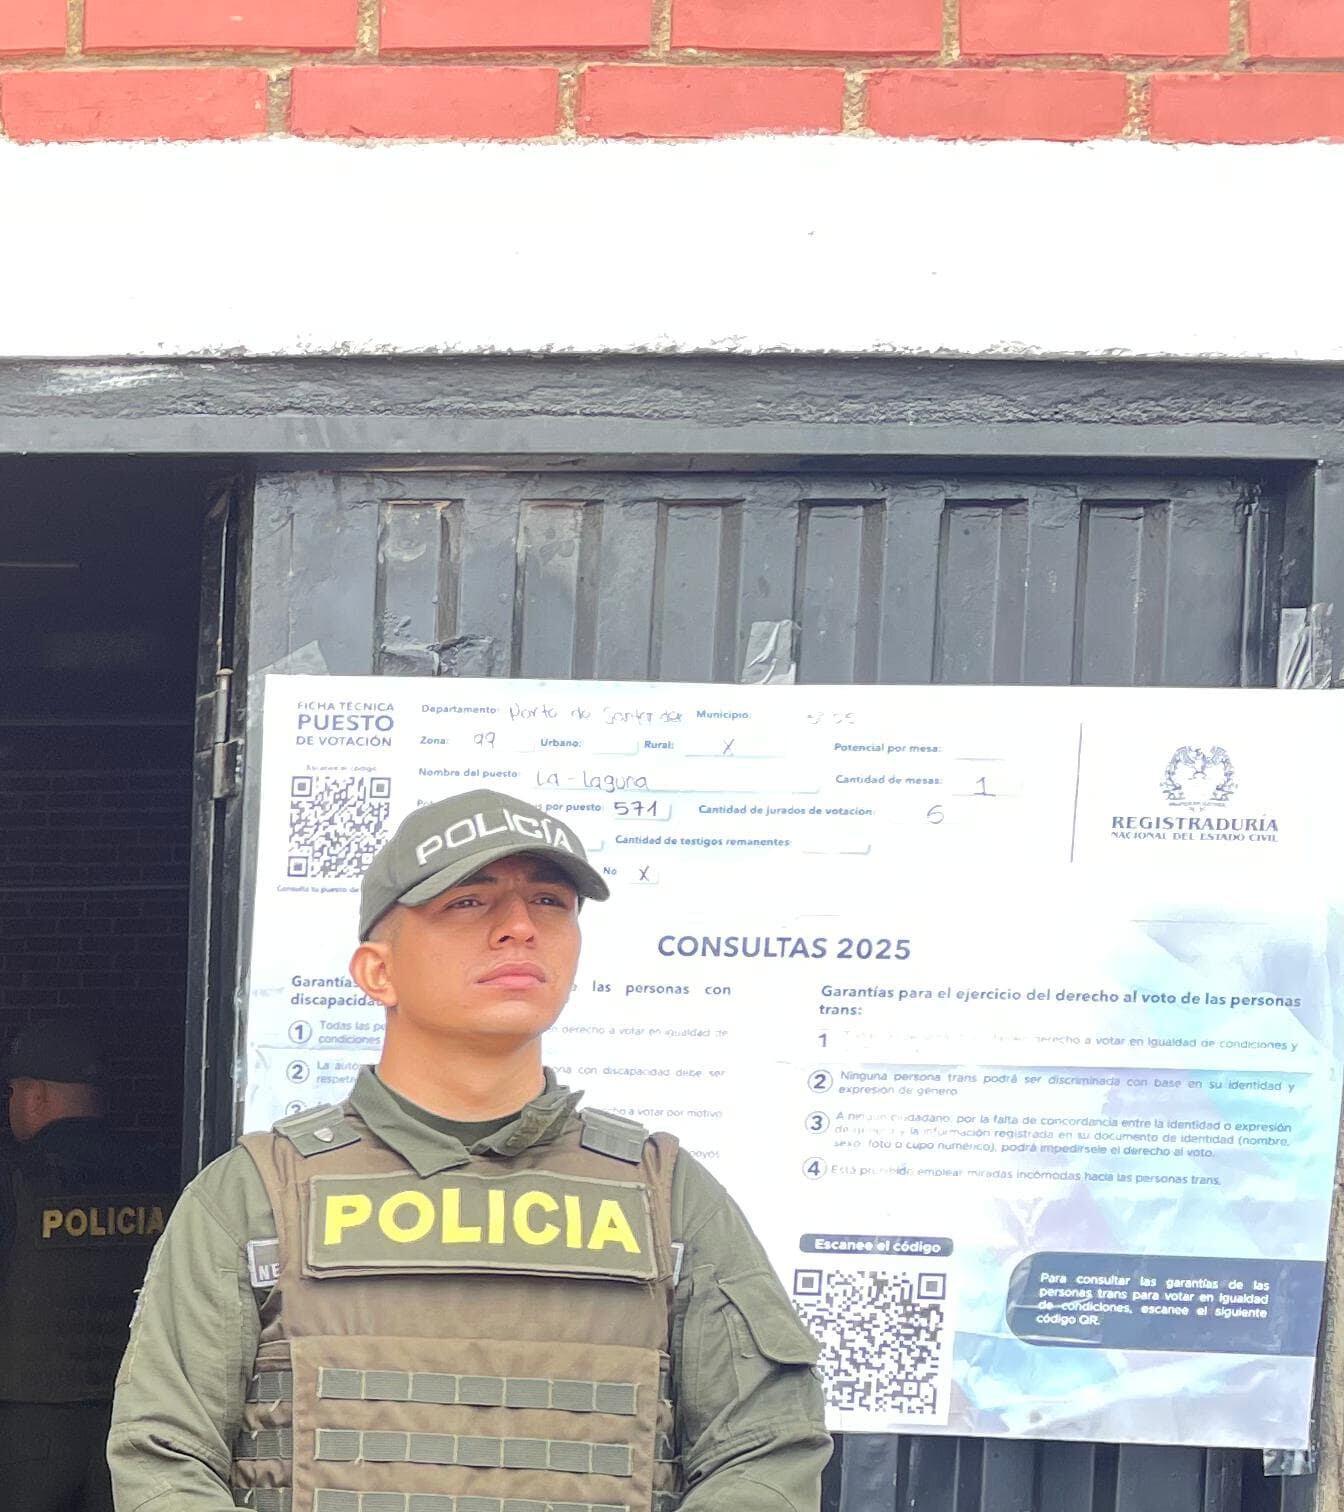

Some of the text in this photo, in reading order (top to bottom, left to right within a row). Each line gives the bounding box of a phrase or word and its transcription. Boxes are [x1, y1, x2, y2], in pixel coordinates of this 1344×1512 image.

[297, 701, 335, 711] FICHA
[297, 714, 394, 732] PUESTO
[696, 710, 751, 720] Municipio:
[296, 735, 392, 747] DE VOTACIÓN
[540, 738, 582, 748] Urbano:
[644, 740, 674, 749] Rural:
[833, 742, 944, 755] Potencial por mesa:
[418, 767, 461, 777] Nombre
[463, 768, 481, 777] del
[835, 775, 886, 784] Cantidad
[545, 803, 564, 813] por
[613, 799, 658, 817] 571
[698, 804, 806, 816] Cantidad de jurados
[1111, 813, 1279, 832] REGISTRADURÍA
[415, 808, 574, 866] POLICÍA
[615, 834, 662, 845] Cantidad
[664, 835, 679, 845] de
[680, 836, 723, 848] testigos
[1111, 831, 1167, 840] NACIONAL
[1172, 832, 1195, 841] DEL
[658, 934, 912, 961] CONSULTAS 2025
[592, 980, 612, 993] las
[625, 983, 690, 997] personas
[704, 985, 731, 996] con
[820, 985, 1302, 1009] Garantías para el ejercicio del derecho al voto de las personas
[819, 1003, 864, 1016] trans:
[817, 1032, 827, 1048] 1
[1096, 1036, 1289, 1050] votar en igualdad condiciones
[840, 1070, 1282, 1092] Ninguna persona trans podrá ser discriminada con base en su identidad
[956, 1115, 977, 1126] por
[993, 1114, 1019, 1126] falta
[1023, 1116, 1038, 1127] de
[1040, 1116, 1119, 1128] concordancia
[1121, 1119, 1152, 1129] entre
[1167, 1119, 1221, 1131] identidad
[1234, 1120, 1293, 1133] expresión
[994, 1128, 1054, 1140] registrada
[1163, 1132, 1178, 1143] de
[1180, 1132, 1235, 1145] identidad
[905, 1142, 1216, 1159] cupo podrá derecho voto.
[1016, 1168, 1082, 1181] incómodas
[1084, 1171, 1114, 1183] hacia
[1117, 1172, 1133, 1183] las
[1135, 1174, 1188, 1185] personas
[1191, 1174, 1222, 1187] trans.
[41, 1206, 165, 1240] POLICIA
[323, 1187, 642, 1254] POLICIA
[814, 1238, 942, 1254] Escanee el código
[1040, 1272, 1270, 1292] Para consultar las garantías de las
[1039, 1287, 1269, 1306] personas trans para votar en igualdad
[1036, 1314, 1077, 1326] código
[1140, 1306, 1190, 1316] escanee
[1196, 1305, 1208, 1316] el
[1214, 1306, 1268, 1319] siguiente
